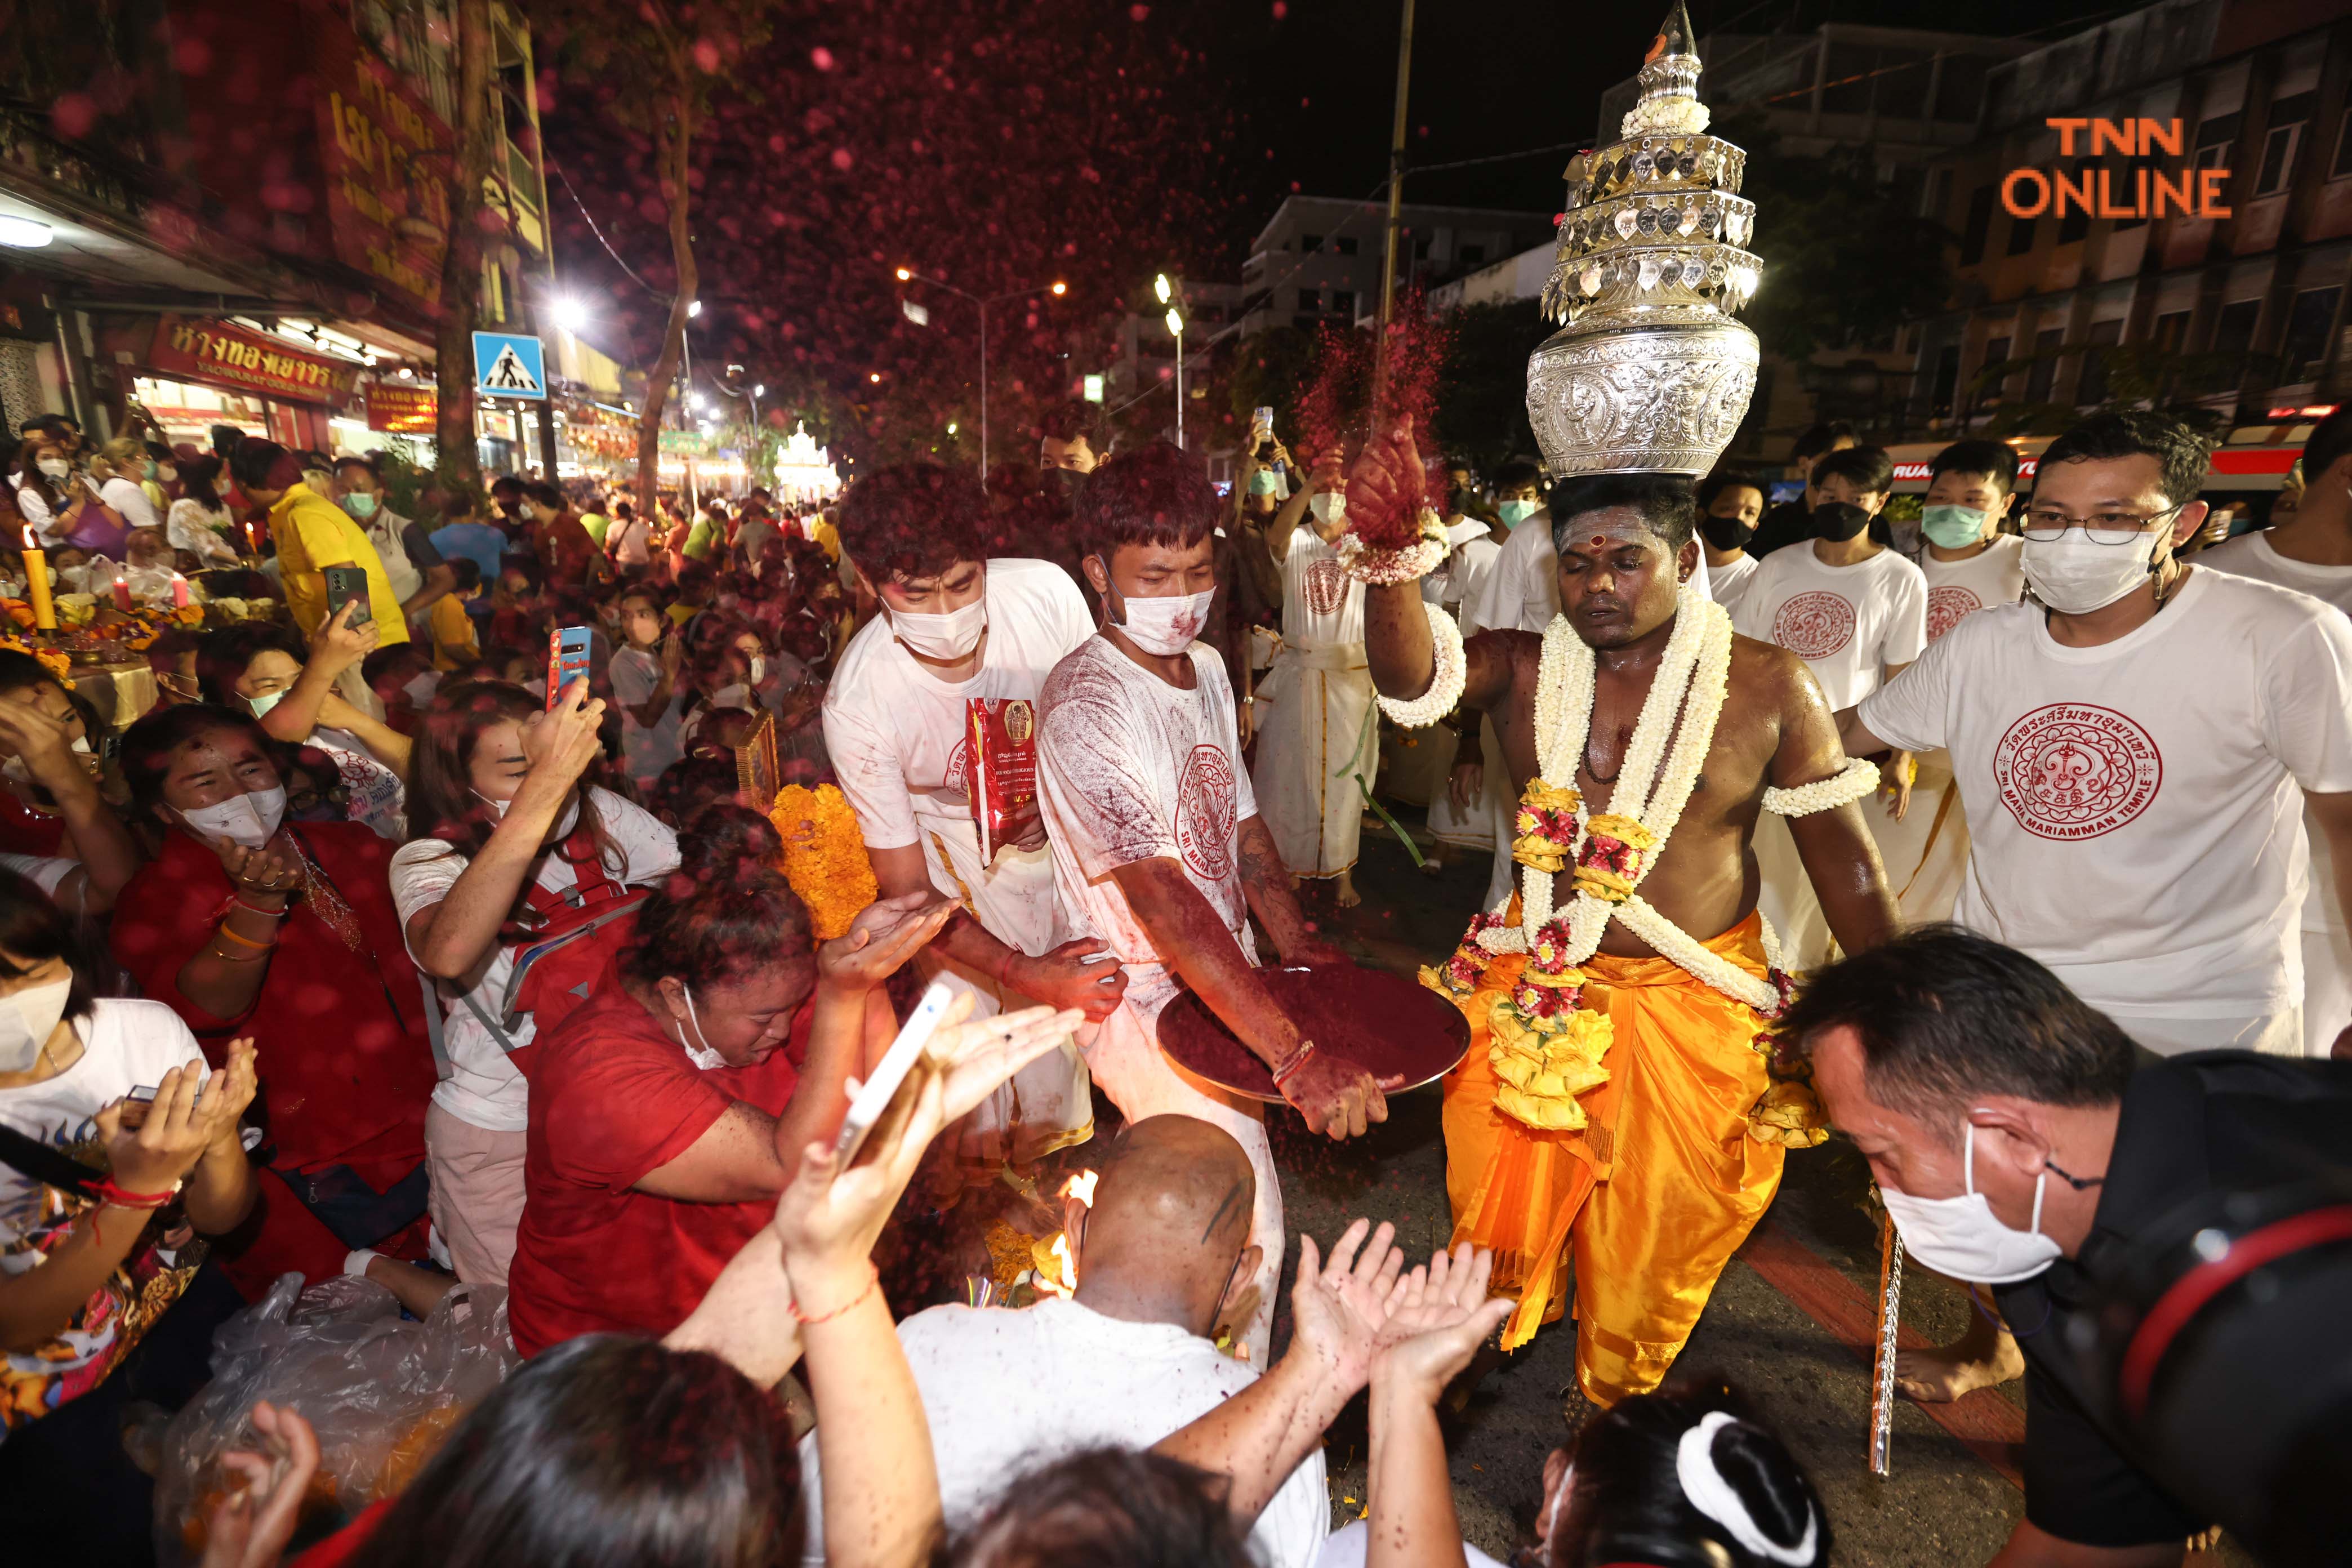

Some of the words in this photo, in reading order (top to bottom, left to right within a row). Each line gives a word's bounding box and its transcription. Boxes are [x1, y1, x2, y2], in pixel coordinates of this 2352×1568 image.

[1893, 465, 1934, 478] RUA
[561, 660, 575, 671] Tom
[2004, 706, 2157, 760] วัดพระศรีมหาอุมาเทวี
[2001, 770, 2009, 786] SRI
[2004, 789, 2026, 819] MAHA
[2117, 779, 2153, 818] TEMPLE
[1181, 830, 1192, 849] SRI
[1187, 849, 1209, 874] MAHA
[1221, 803, 1235, 841] TEMPLE
[2025, 816, 2118, 836] MARIAMMAN
